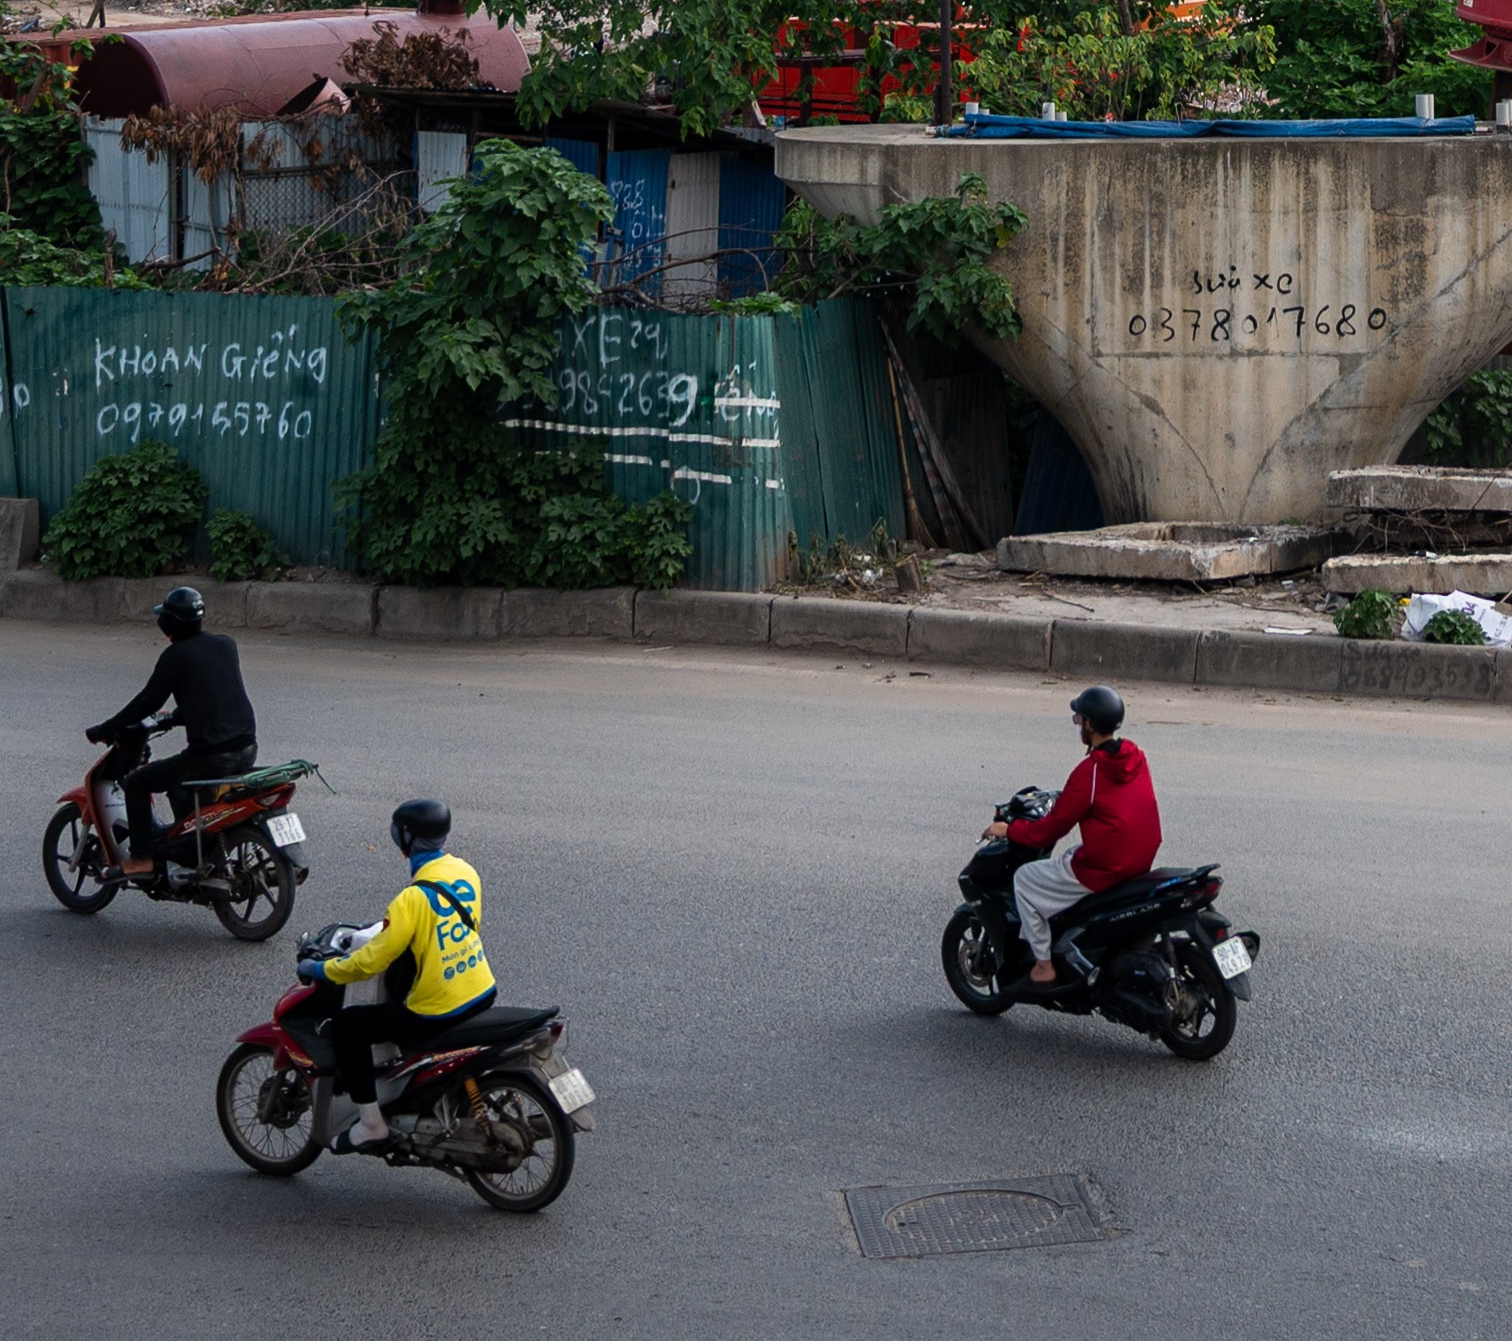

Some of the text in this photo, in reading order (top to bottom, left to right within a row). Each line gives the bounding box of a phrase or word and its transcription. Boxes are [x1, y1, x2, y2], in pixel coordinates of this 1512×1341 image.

[1128, 304, 1388, 342] 0378017680
[95, 337, 207, 391] KHOAN
[97, 401, 312, 443] 0979155760
